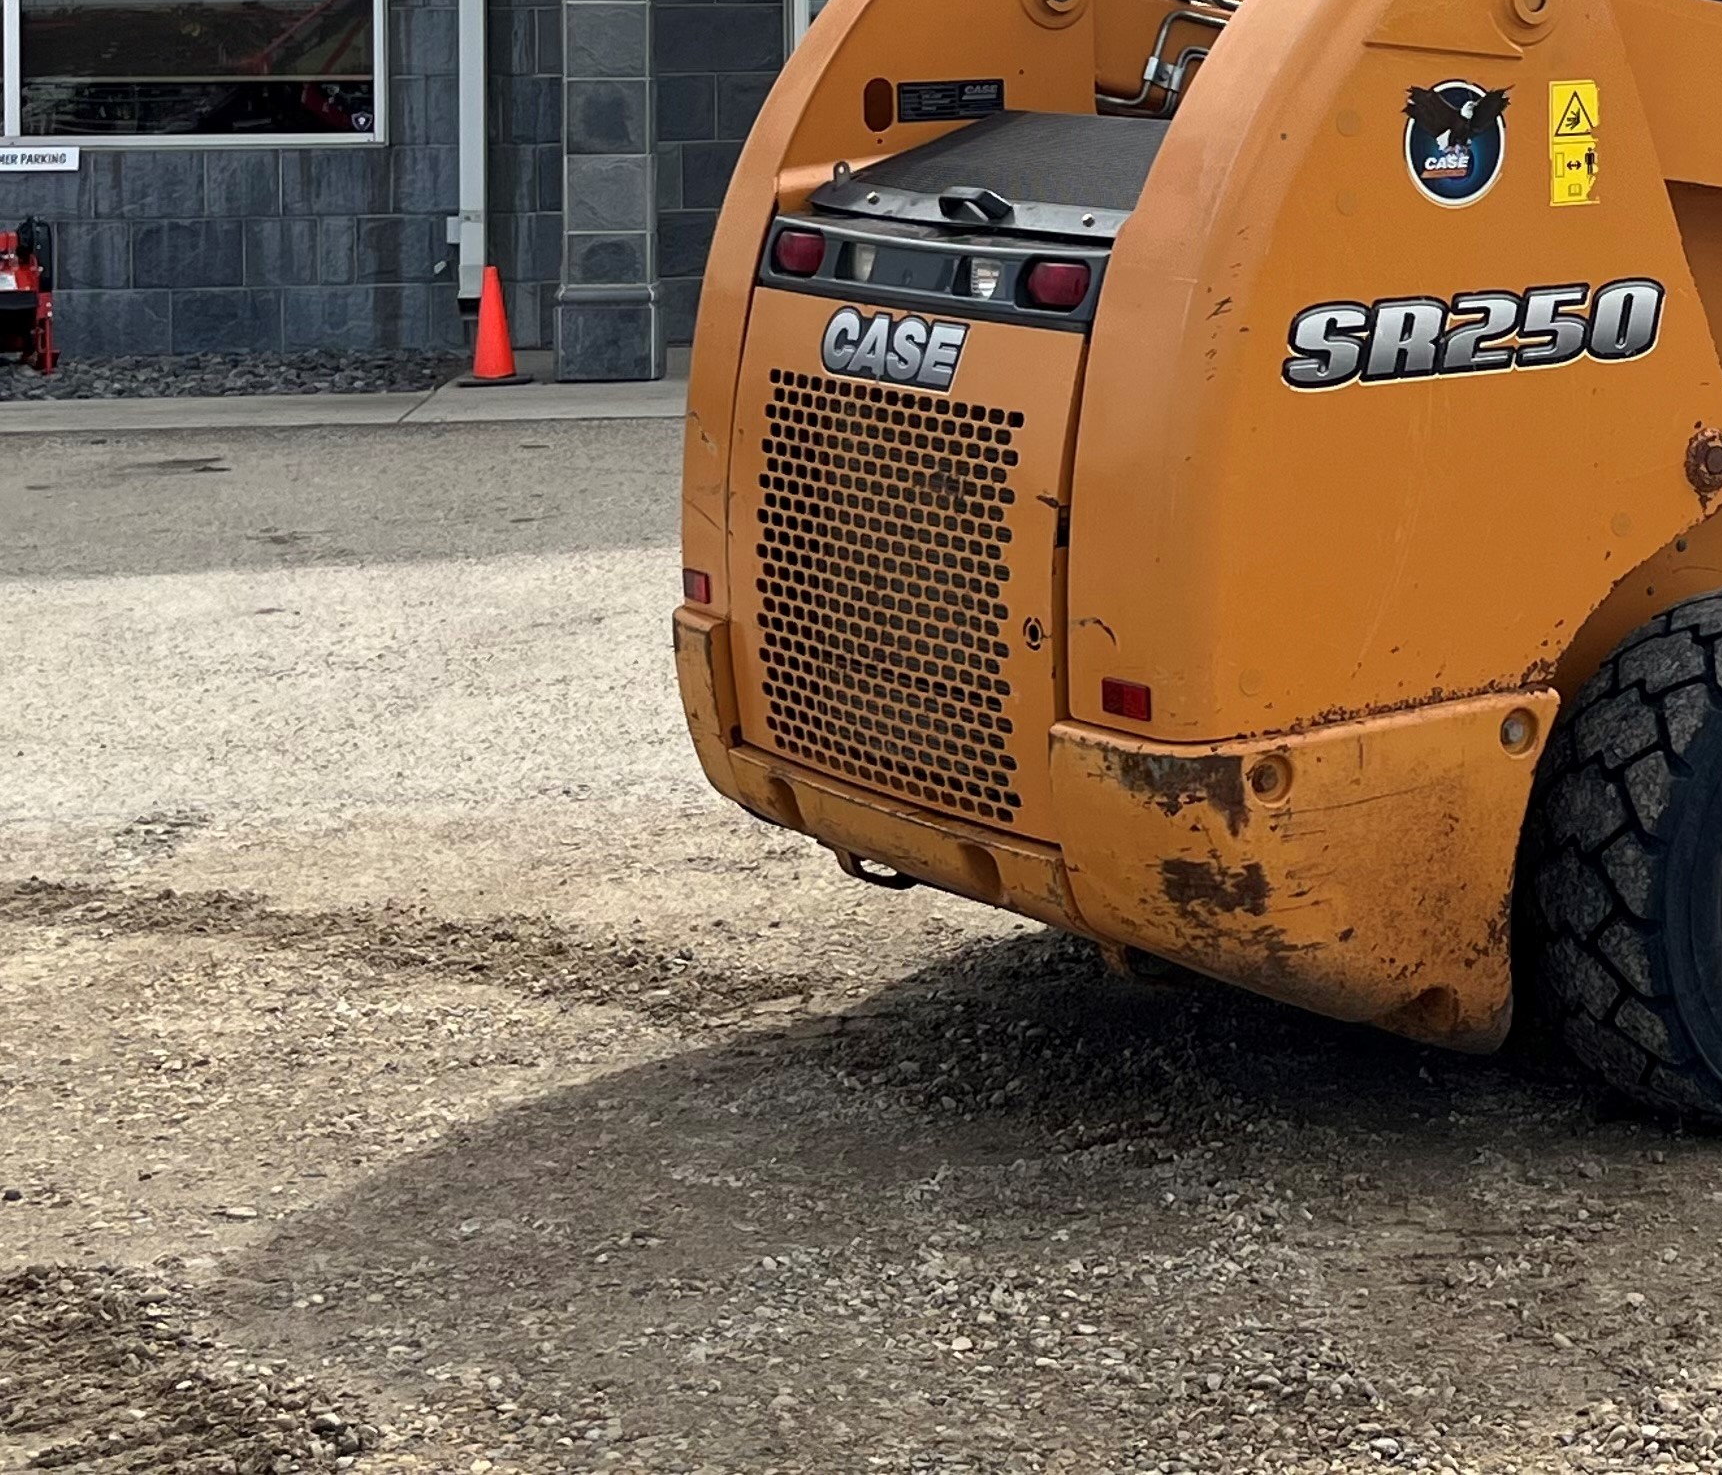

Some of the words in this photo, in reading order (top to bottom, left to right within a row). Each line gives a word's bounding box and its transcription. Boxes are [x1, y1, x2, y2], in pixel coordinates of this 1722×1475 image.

[964, 85, 998, 94] CASE
[20, 152, 67, 165] PARKING
[1424, 154, 1470, 171] CASE
[1282, 278, 1664, 391] SR250
[822, 306, 970, 392] CASE
